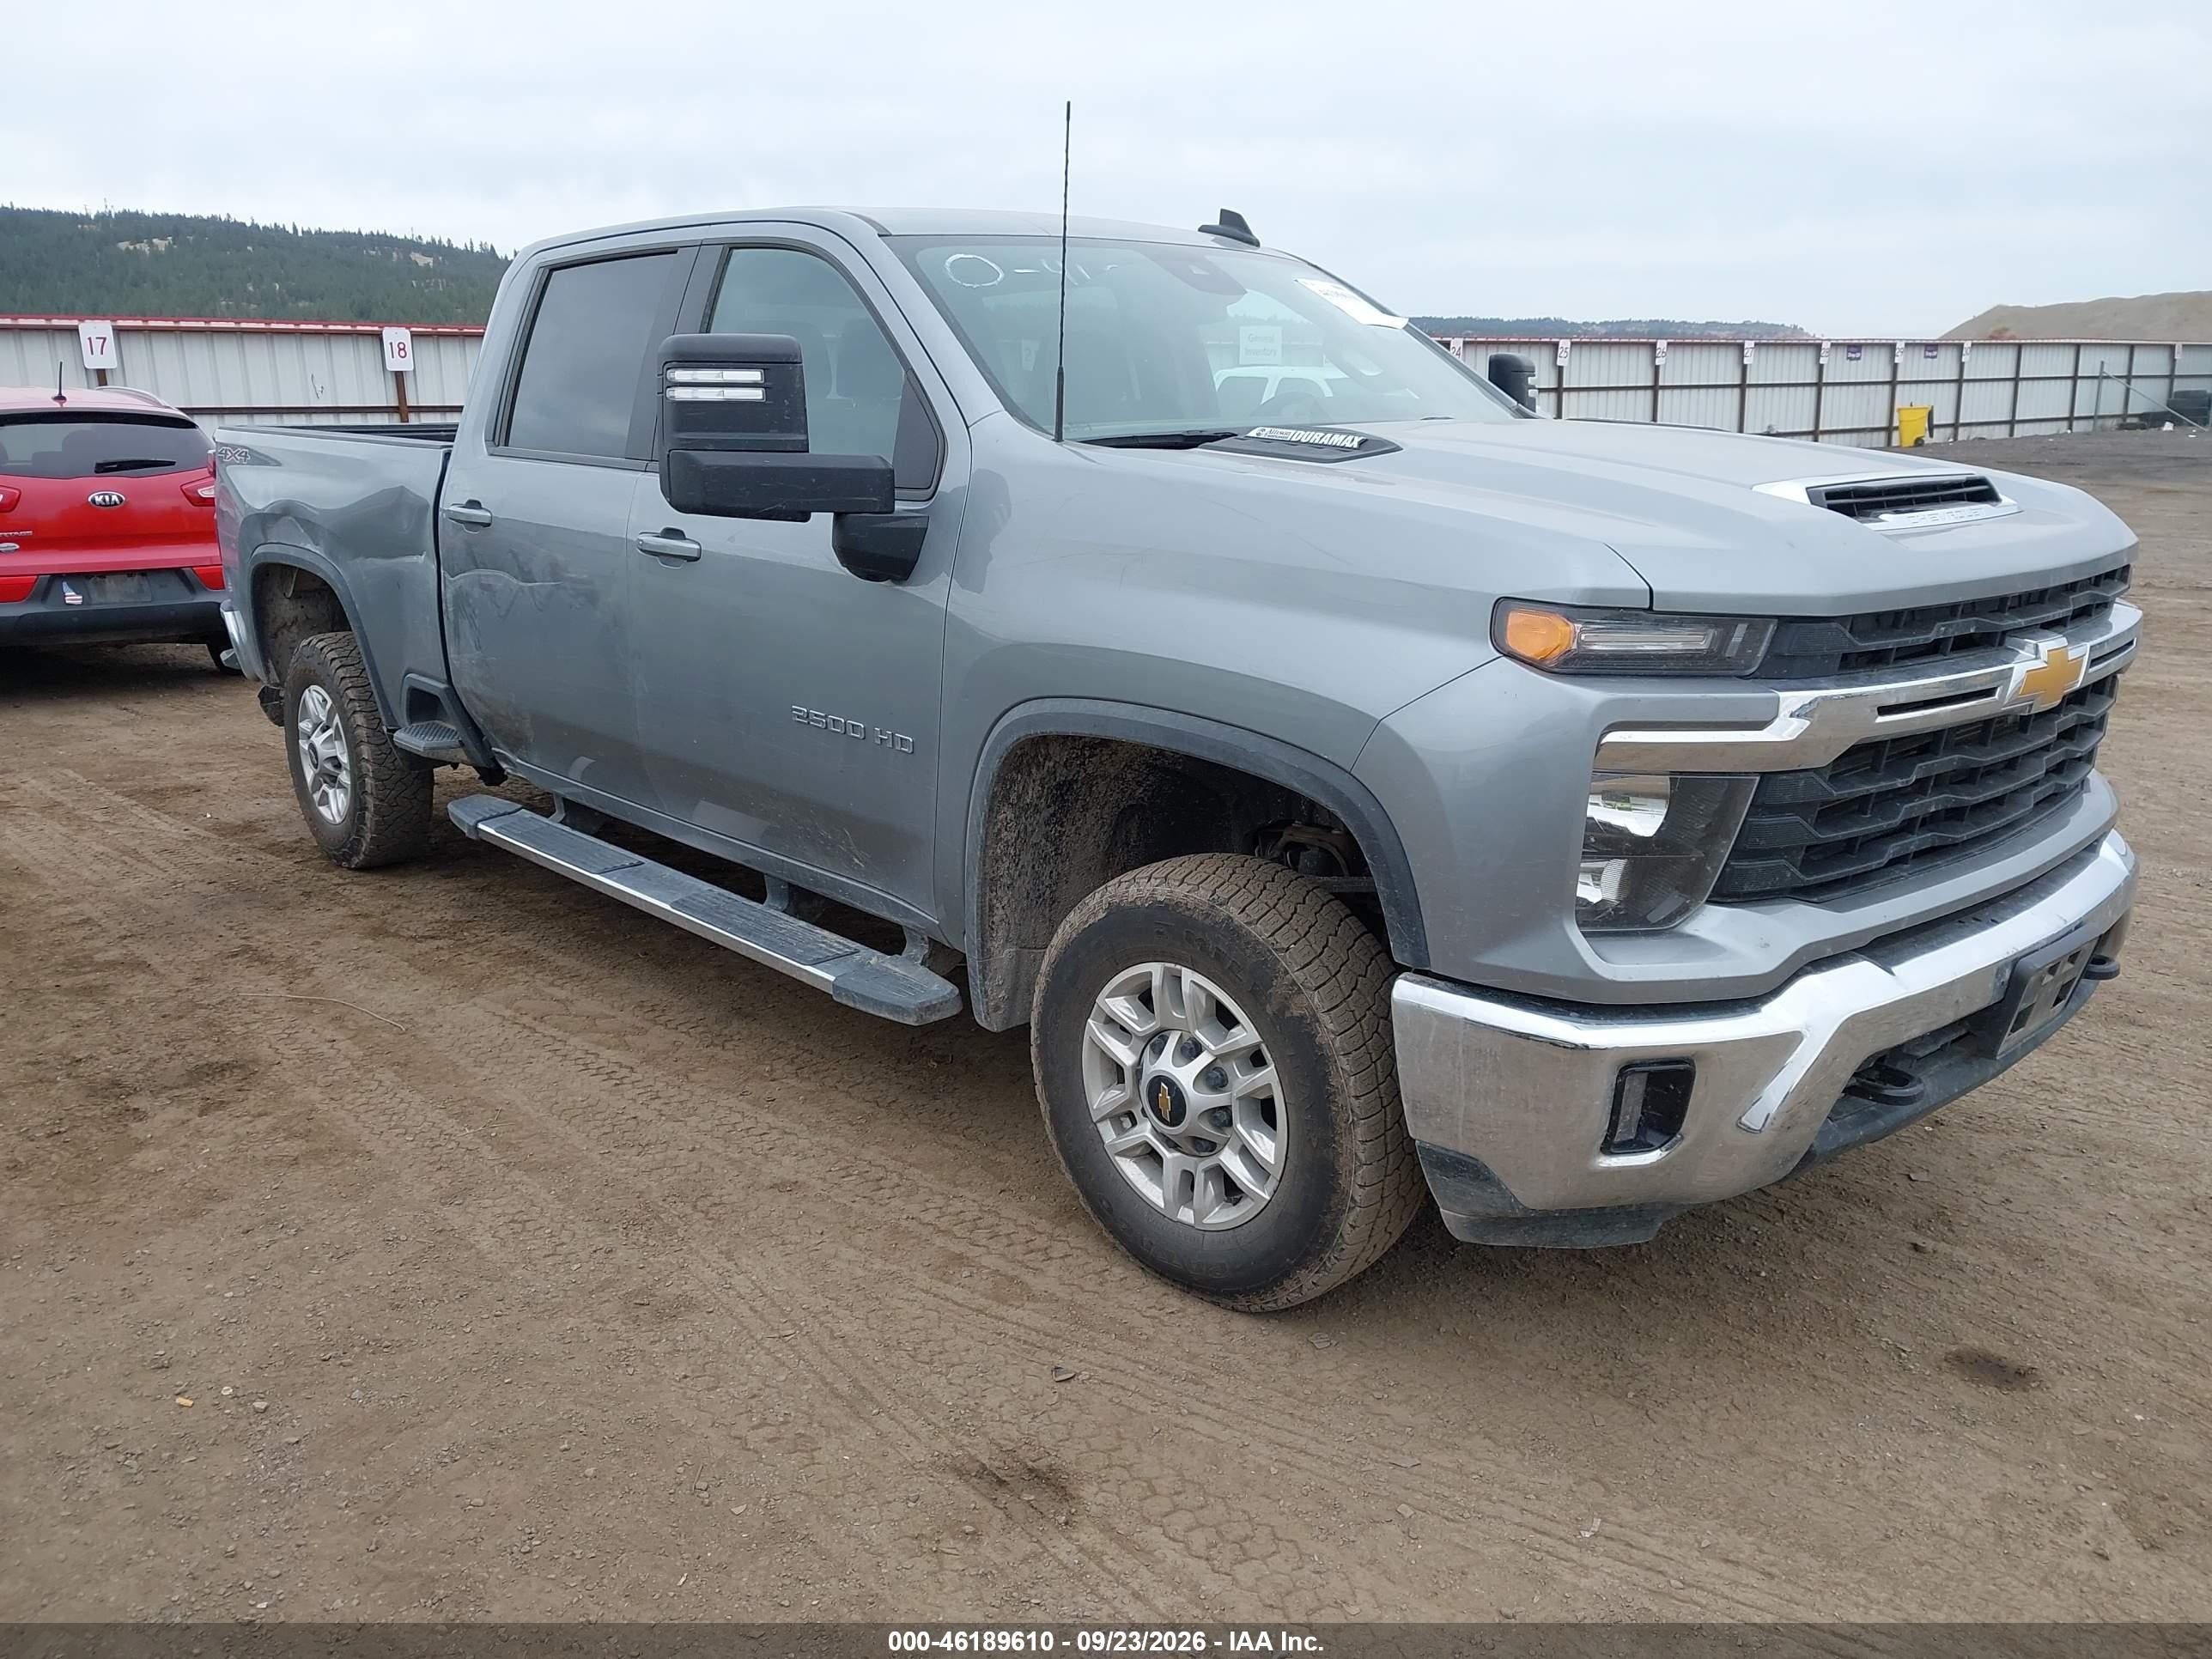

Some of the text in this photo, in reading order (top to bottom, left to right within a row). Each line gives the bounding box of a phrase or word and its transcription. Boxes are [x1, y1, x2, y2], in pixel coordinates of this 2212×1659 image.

[87, 336, 107, 356] 17
[389, 341, 408, 359] 18
[1451, 346, 1462, 358] 24
[1559, 346, 1569, 359] 25
[1656, 347, 1667, 358] 26
[1743, 347, 1754, 357] 27
[1291, 430, 1364, 447] DURAMAX
[217, 447, 251, 464] 4X4
[94, 495, 120, 506] KIA
[791, 705, 914, 754] 2500 HD
